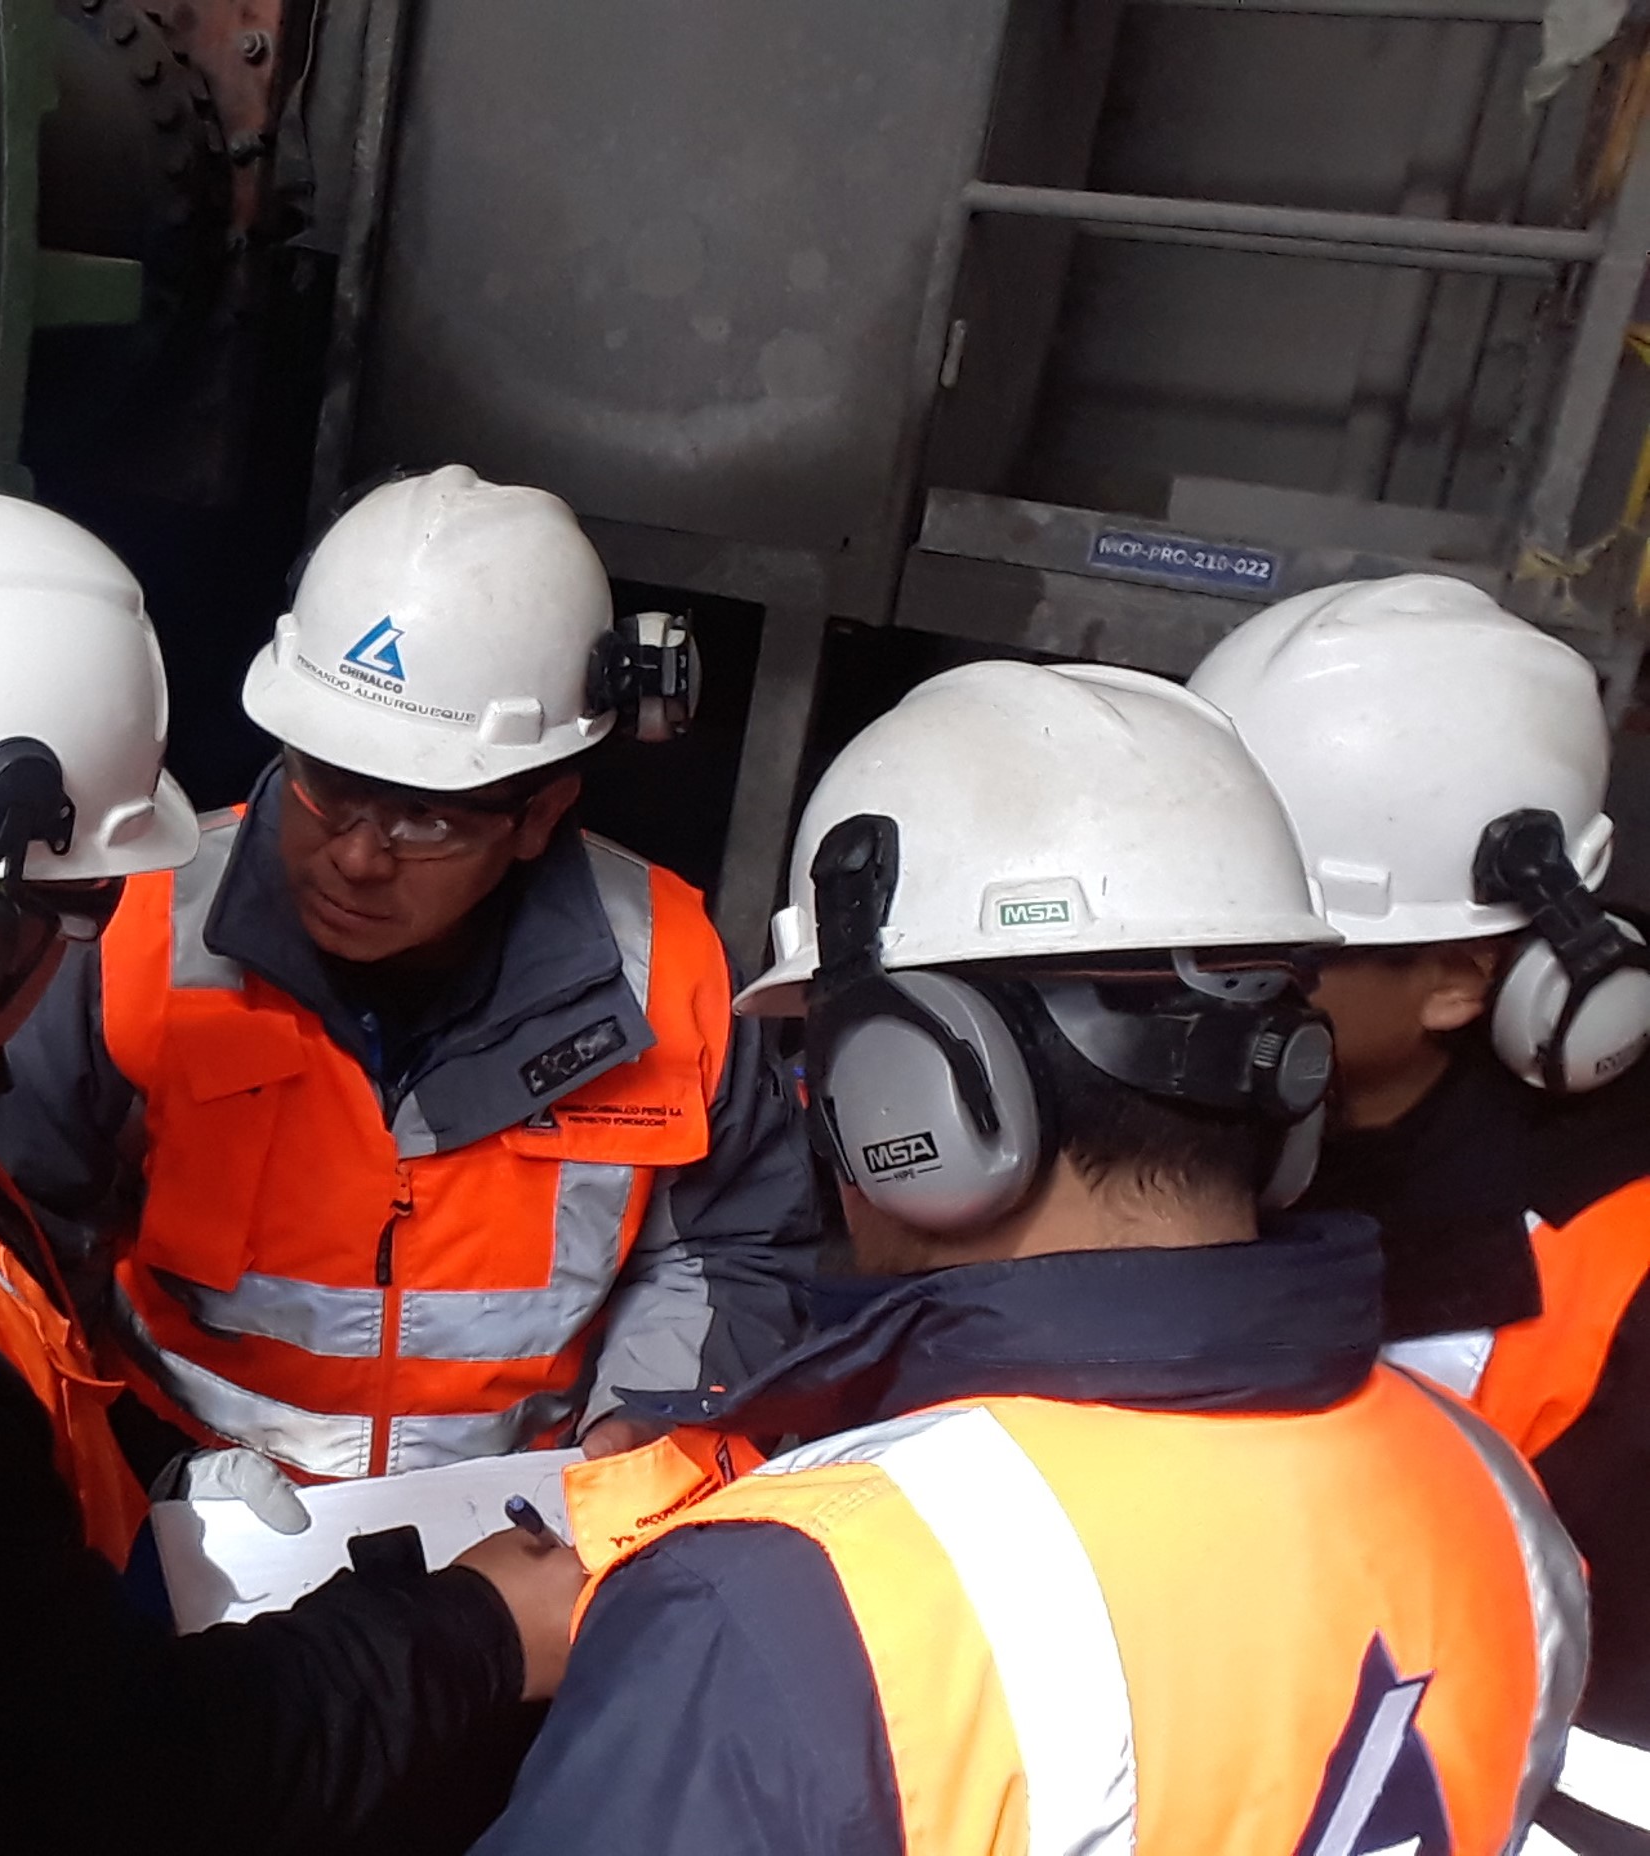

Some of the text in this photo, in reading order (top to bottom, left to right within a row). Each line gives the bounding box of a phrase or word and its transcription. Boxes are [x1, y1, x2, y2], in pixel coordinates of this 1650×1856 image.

[339, 663, 403, 695] CHINALCO
[354, 686, 477, 723] ALBURQUEQUE
[1004, 903, 1066, 924] MSA
[866, 1135, 935, 1171] MSA
